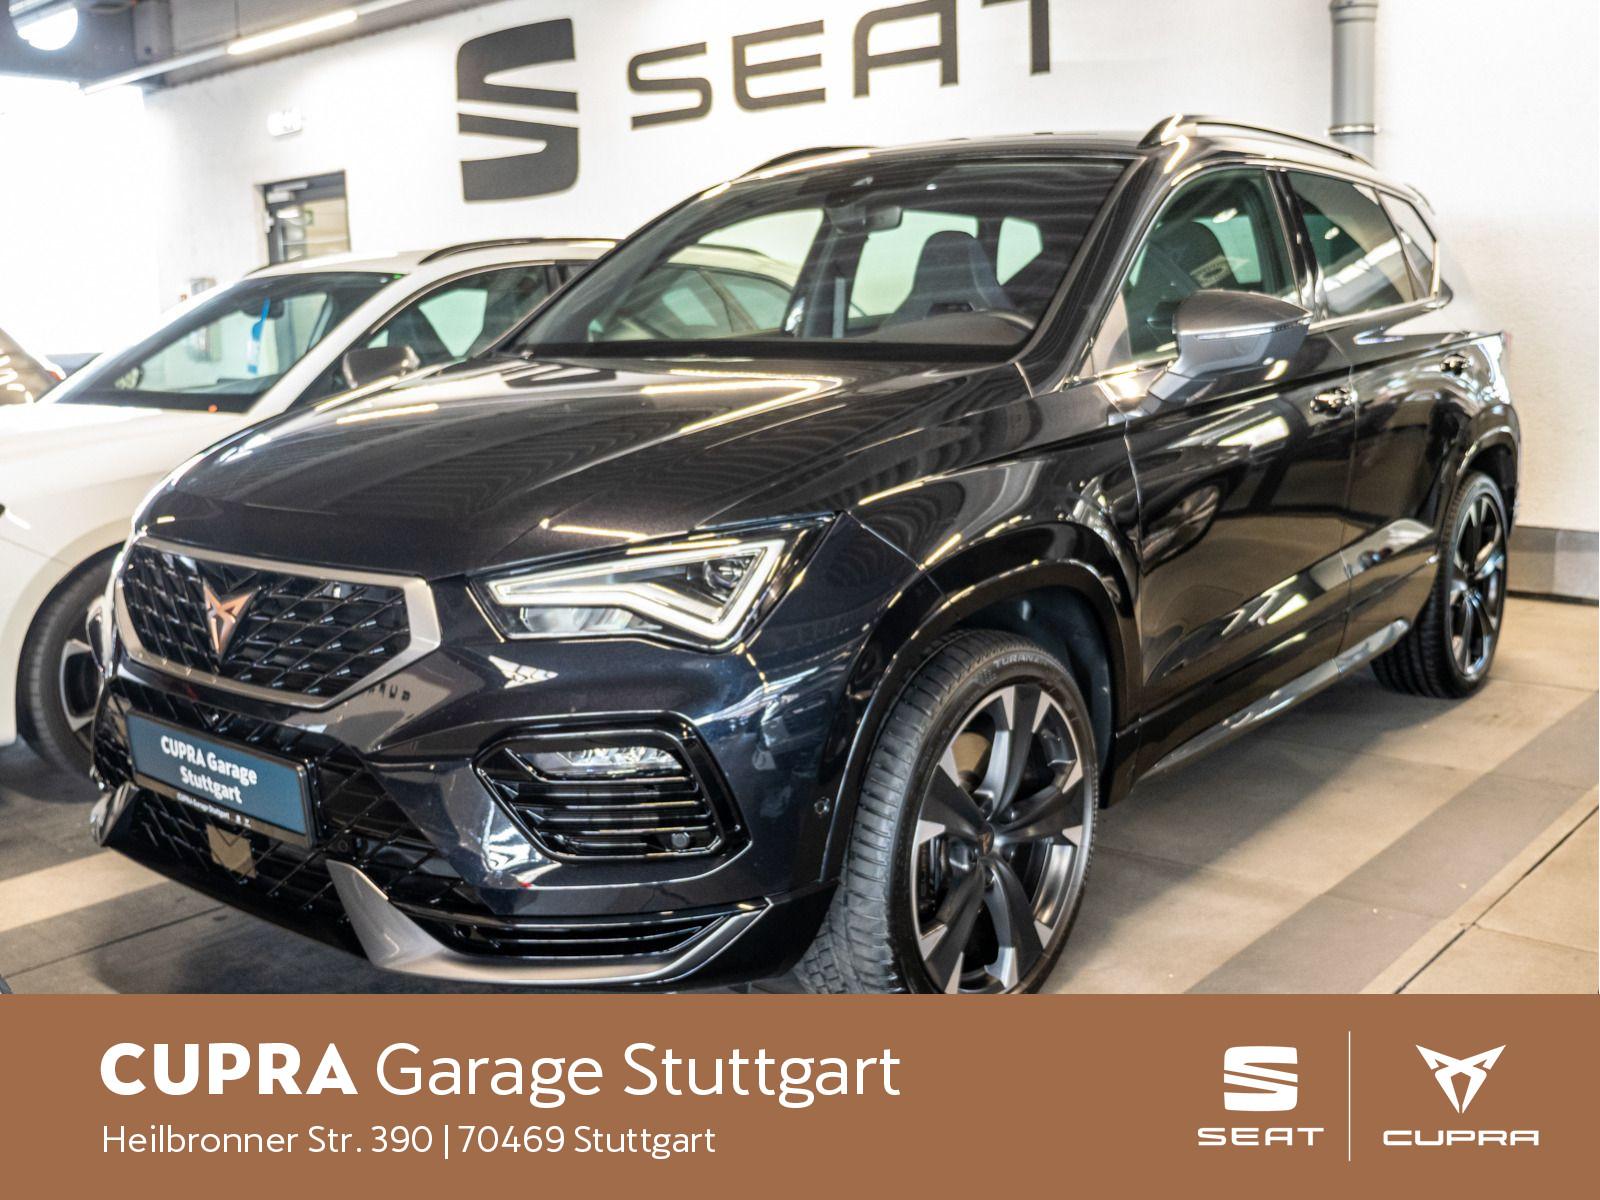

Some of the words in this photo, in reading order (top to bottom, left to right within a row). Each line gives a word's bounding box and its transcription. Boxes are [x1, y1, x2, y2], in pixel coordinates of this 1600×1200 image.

[627, 0, 1052, 131] SEAT
[160, 735, 206, 768] CUPRA
[206, 751, 258, 787] Garage
[179, 765, 243, 805] Stuttgart
